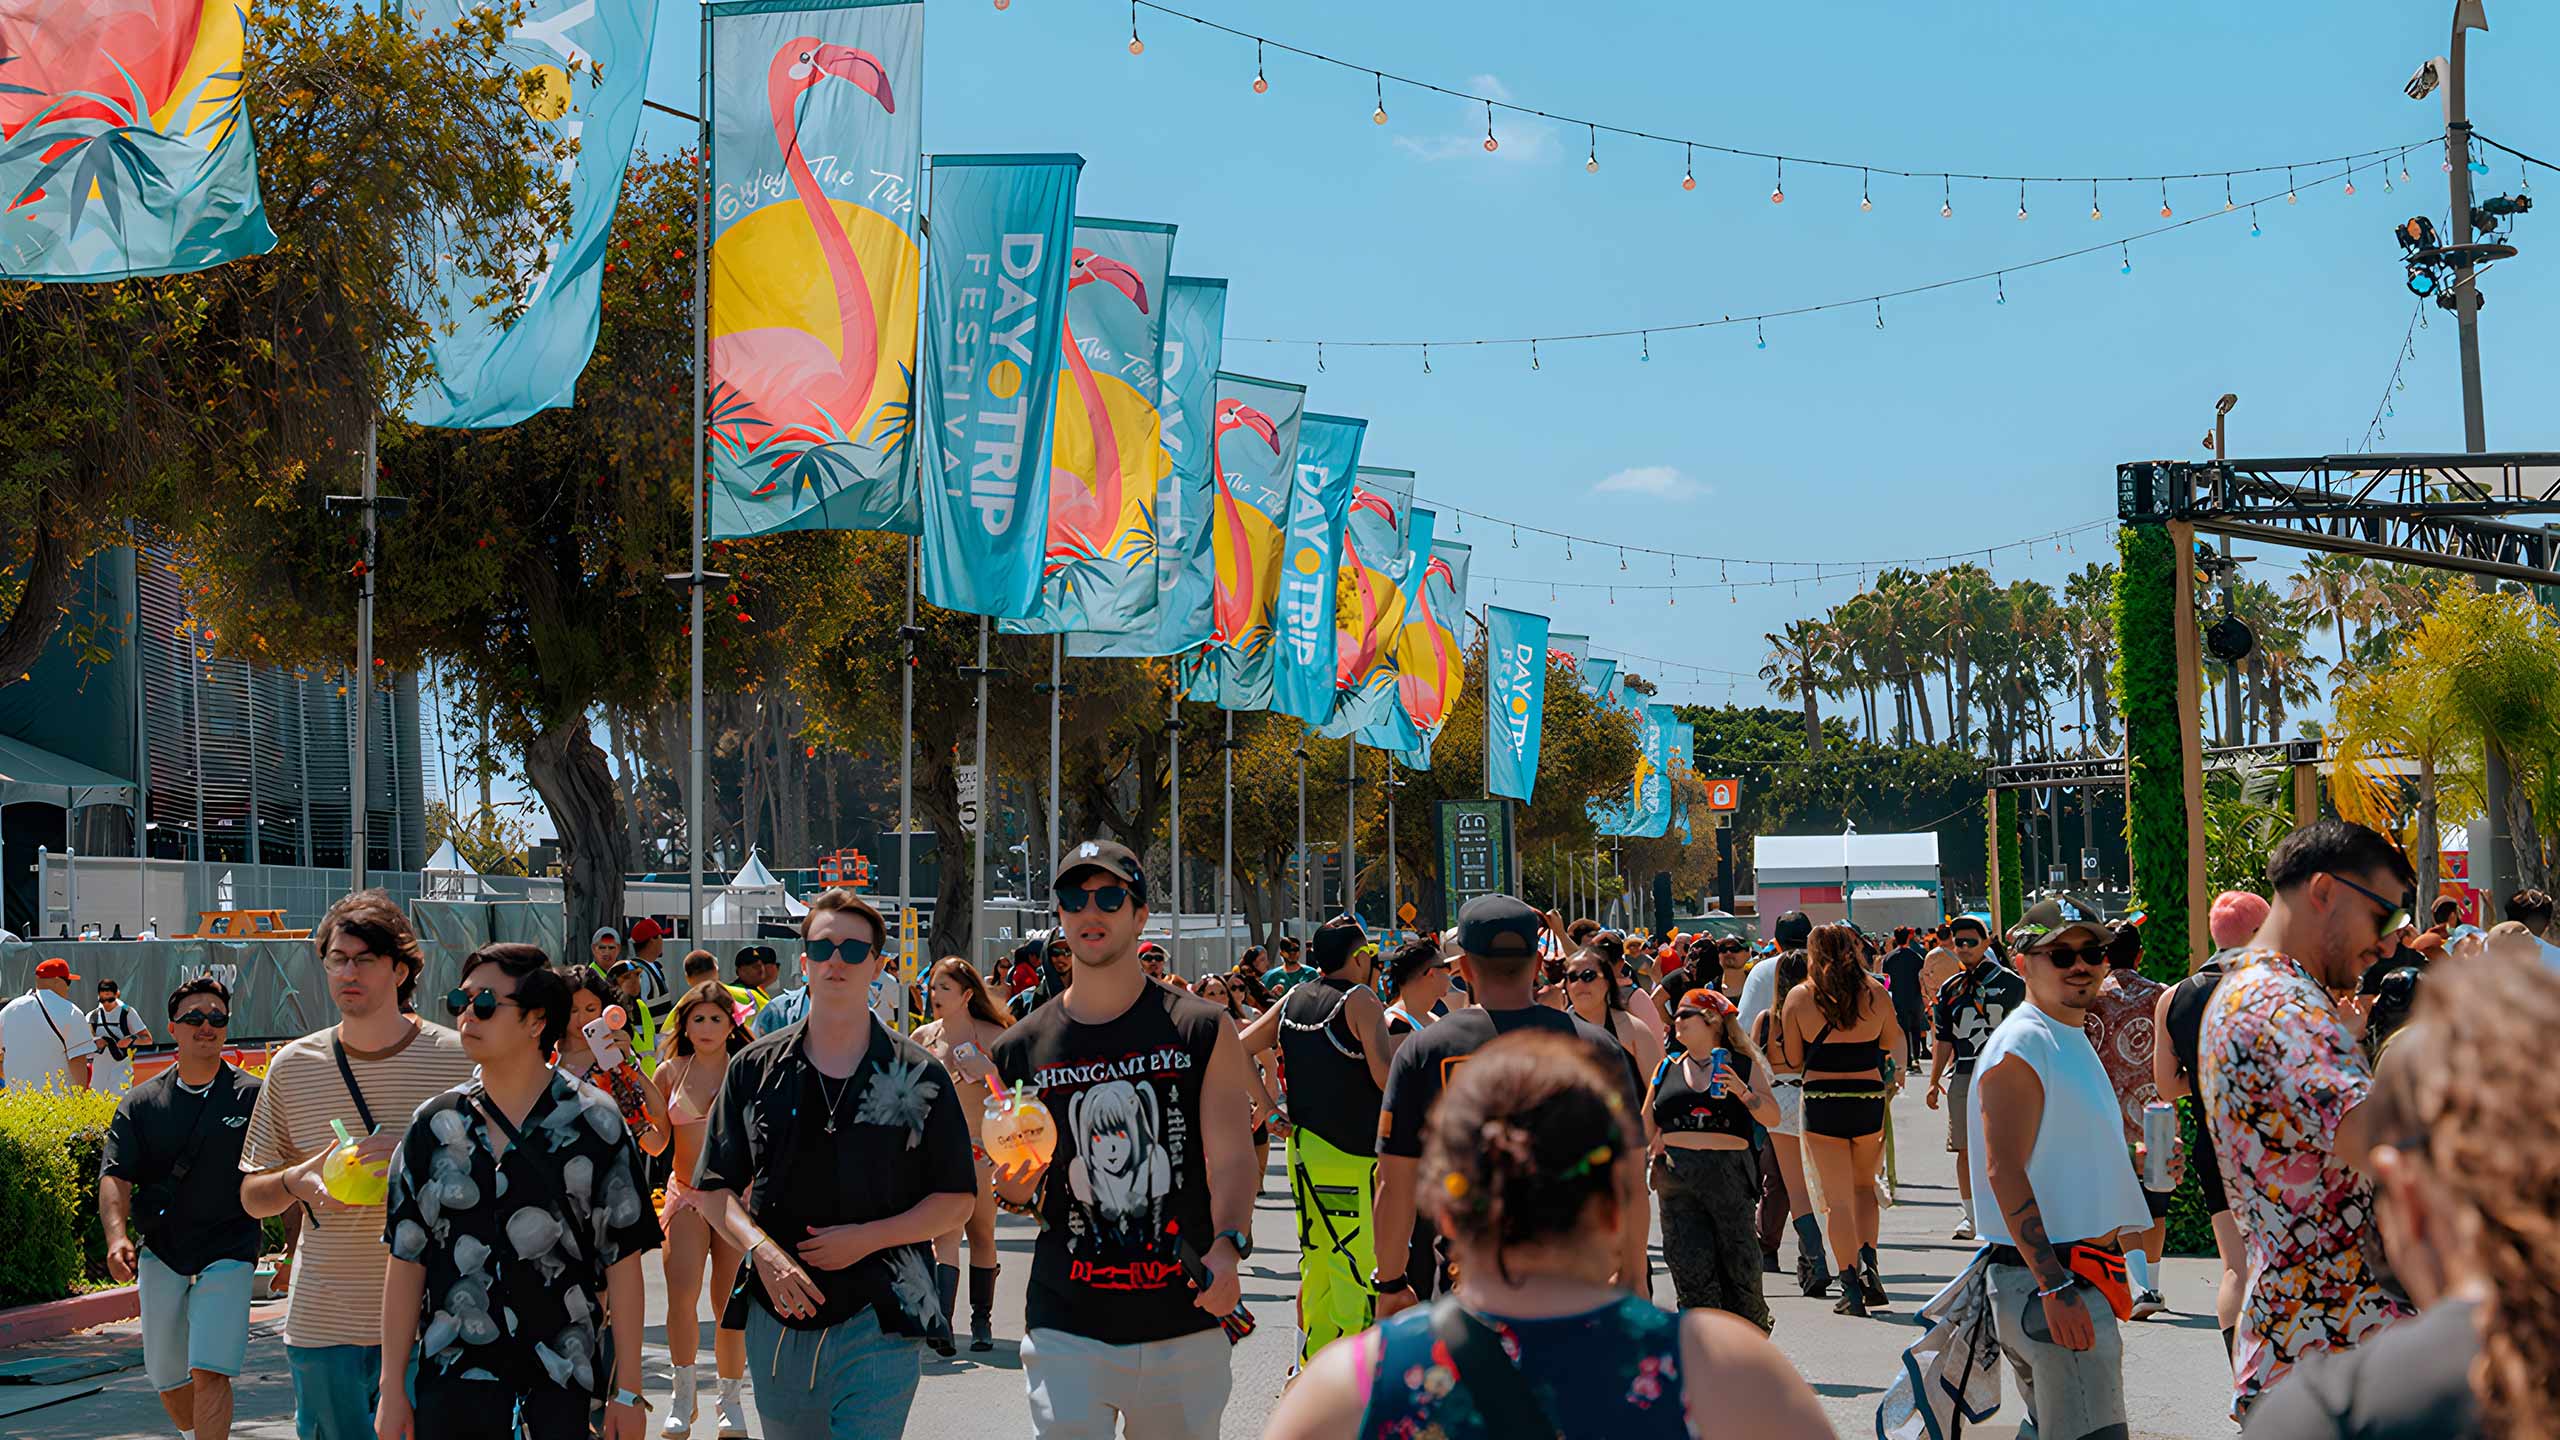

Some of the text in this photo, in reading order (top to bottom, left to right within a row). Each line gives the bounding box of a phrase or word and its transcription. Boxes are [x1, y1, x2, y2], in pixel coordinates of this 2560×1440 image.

[716, 155, 913, 221] Enjoy The Trip
[970, 233, 1044, 536] DAY TRIP
[1075, 337, 1111, 361] The
[1287, 463, 1329, 666] DAY TRIP
[1509, 643, 1533, 762] DAY TR
